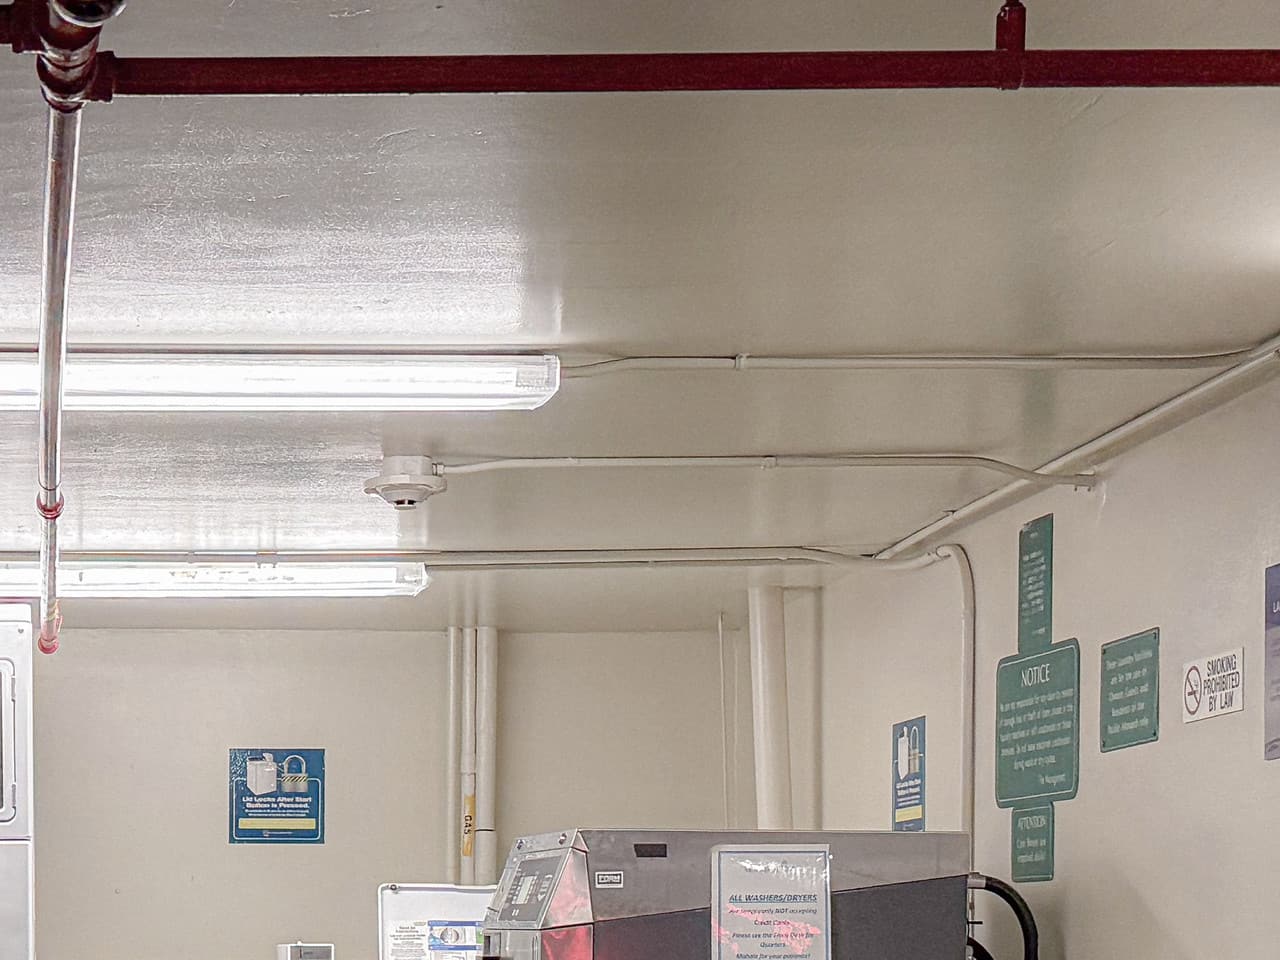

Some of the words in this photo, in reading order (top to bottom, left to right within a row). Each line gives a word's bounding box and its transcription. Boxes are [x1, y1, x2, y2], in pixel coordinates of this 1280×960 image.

[1021, 664, 1050, 687] NOTICE
[1206, 654, 1237, 677] SMOKING
[1203, 671, 1240, 696] PROHIBITED
[1208, 695, 1217, 712] BY
[1220, 690, 1233, 709] LAW
[464, 815, 473, 834] GAS
